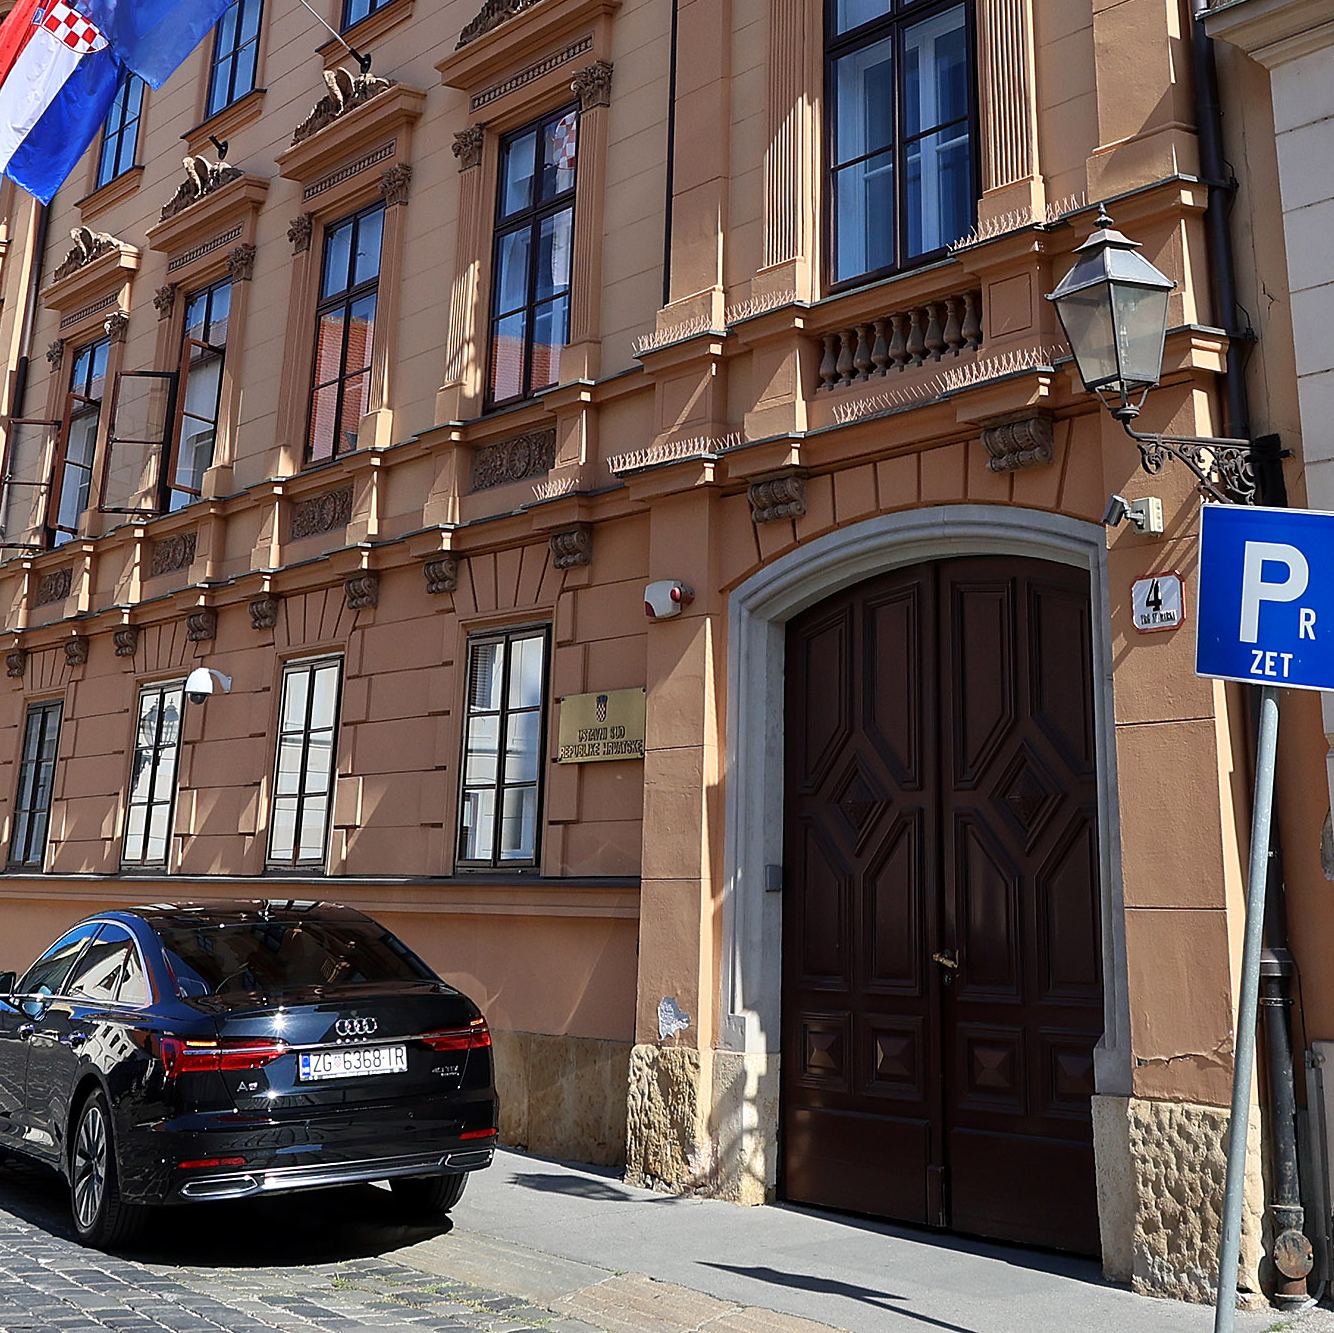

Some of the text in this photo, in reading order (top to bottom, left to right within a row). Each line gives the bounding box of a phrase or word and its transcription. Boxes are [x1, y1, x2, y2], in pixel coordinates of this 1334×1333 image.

[1146, 578, 1162, 612] 4
[1239, 541, 1309, 644] P
[1299, 608, 1316, 641] R
[1250, 650, 1293, 678] ZET
[578, 725, 626, 743] USTAVNI SUD
[560, 739, 644, 759] REPUBLIKE HRVATSKE
[313, 1052, 332, 1073] ZG
